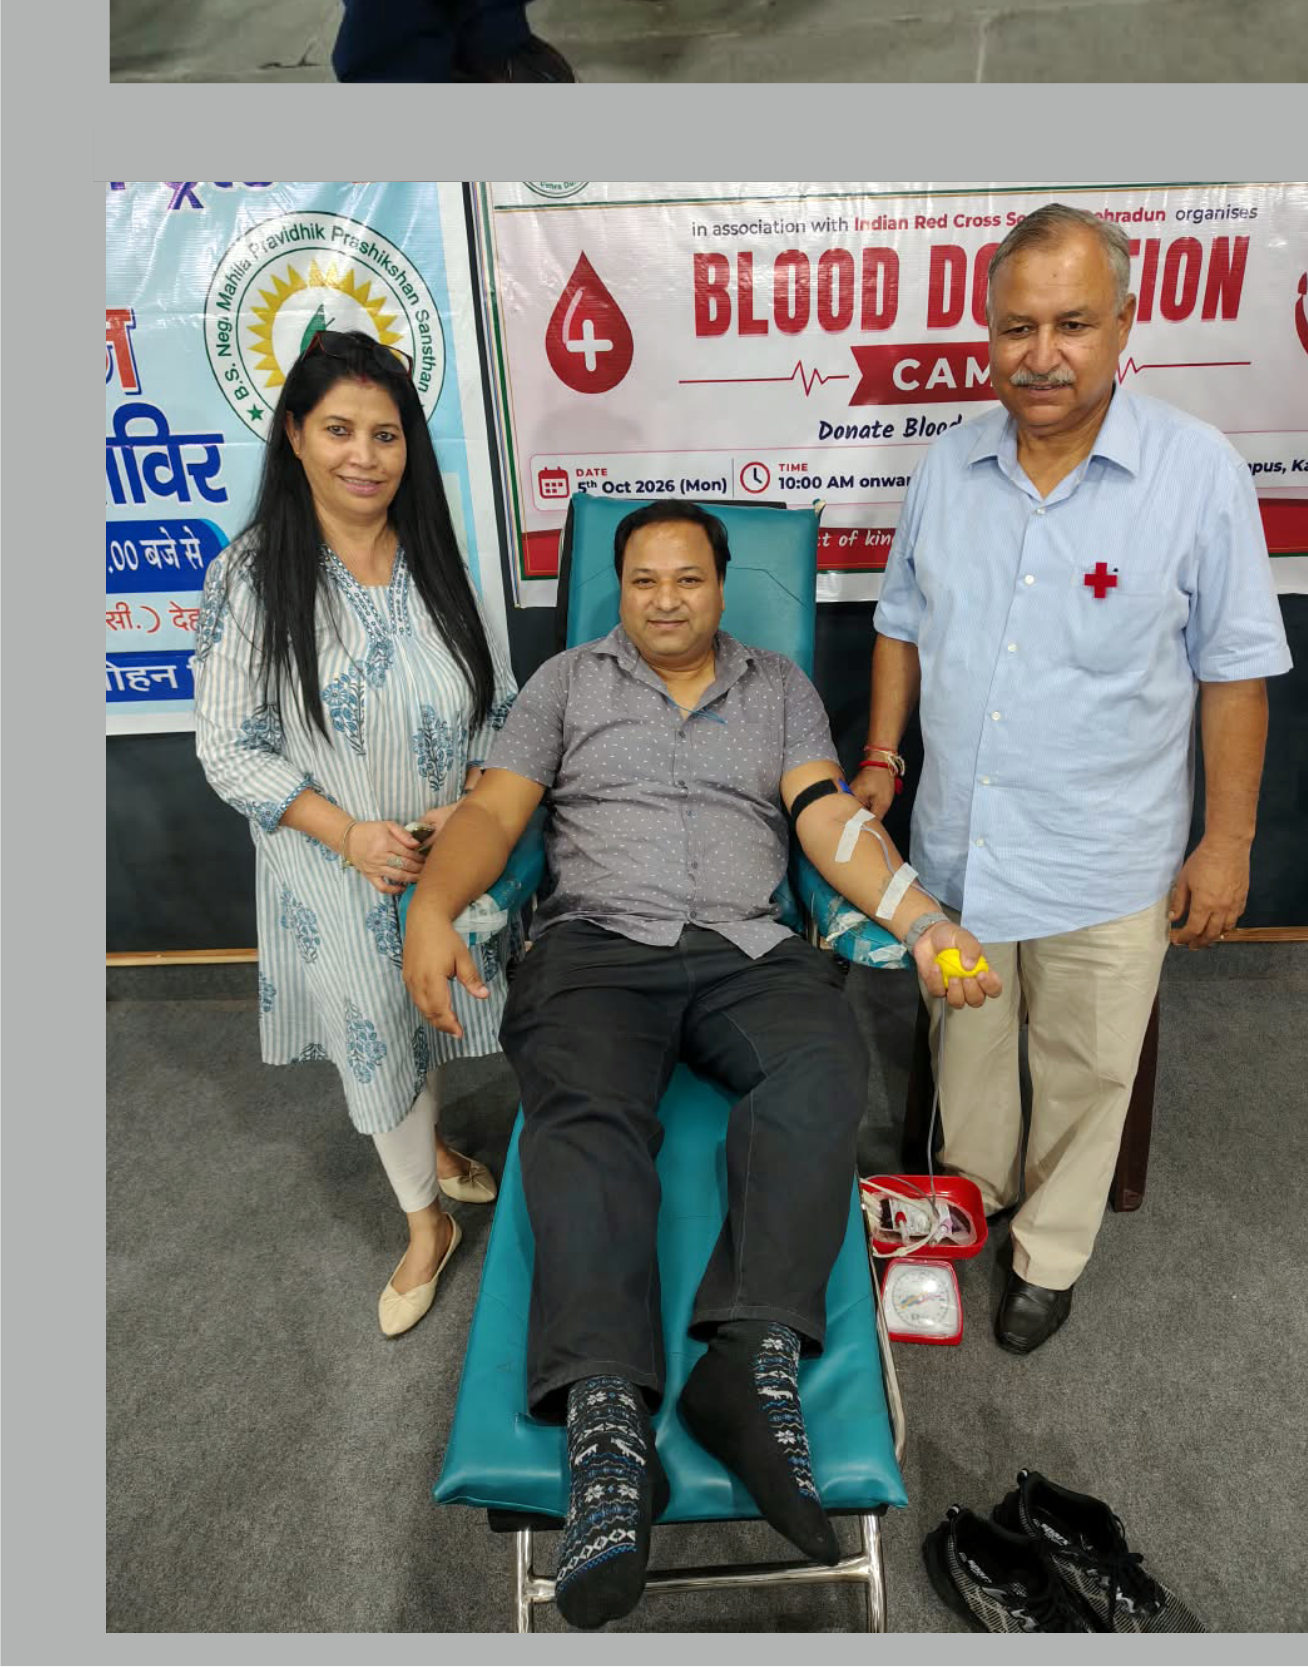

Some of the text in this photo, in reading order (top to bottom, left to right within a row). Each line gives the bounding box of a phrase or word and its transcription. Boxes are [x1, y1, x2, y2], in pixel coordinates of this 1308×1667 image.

[692, 222, 707, 237] in
[713, 219, 805, 236] association
[811, 216, 848, 233] with
[854, 214, 909, 232] Indian
[915, 212, 948, 230] Red
[953, 211, 1001, 229] Cross
[1175, 204, 1258, 224] organises
[693, 246, 900, 339] BLOOD
[215, 223, 437, 401] B.S. Negi Mahila Pravidhik Prashikshan Sansthan
[892, 356, 993, 391] CAM
[818, 420, 894, 440] Donate
[576, 468, 608, 477] DATE
[779, 463, 808, 472] TIME
[602, 480, 631, 494] Oct
[635, 479, 675, 493] 2026
[680, 477, 727, 495] (Mon)
[778, 475, 911, 490] 10:00 AM onwar
[140, 527, 180, 570] बजे
[180, 526, 204, 569] से
[839, 530, 858, 546] of
